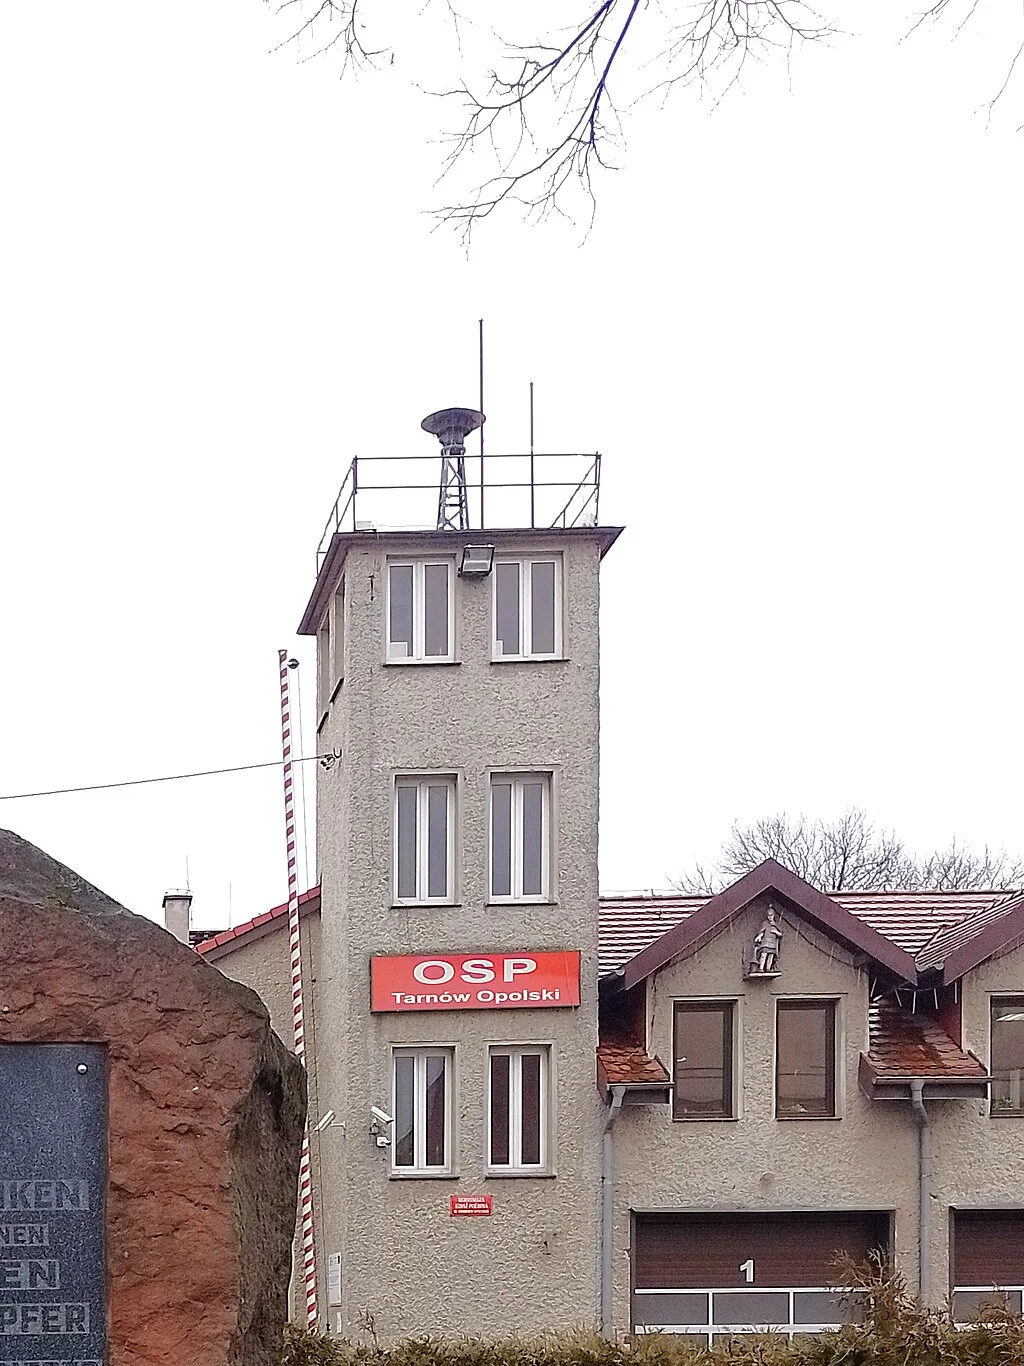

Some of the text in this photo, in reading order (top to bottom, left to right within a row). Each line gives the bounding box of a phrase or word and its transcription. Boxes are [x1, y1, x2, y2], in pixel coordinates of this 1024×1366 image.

[413, 957, 538, 985] OSP
[391, 988, 561, 1005] Tarnów Opolski
[738, 1259, 756, 1283] 1
